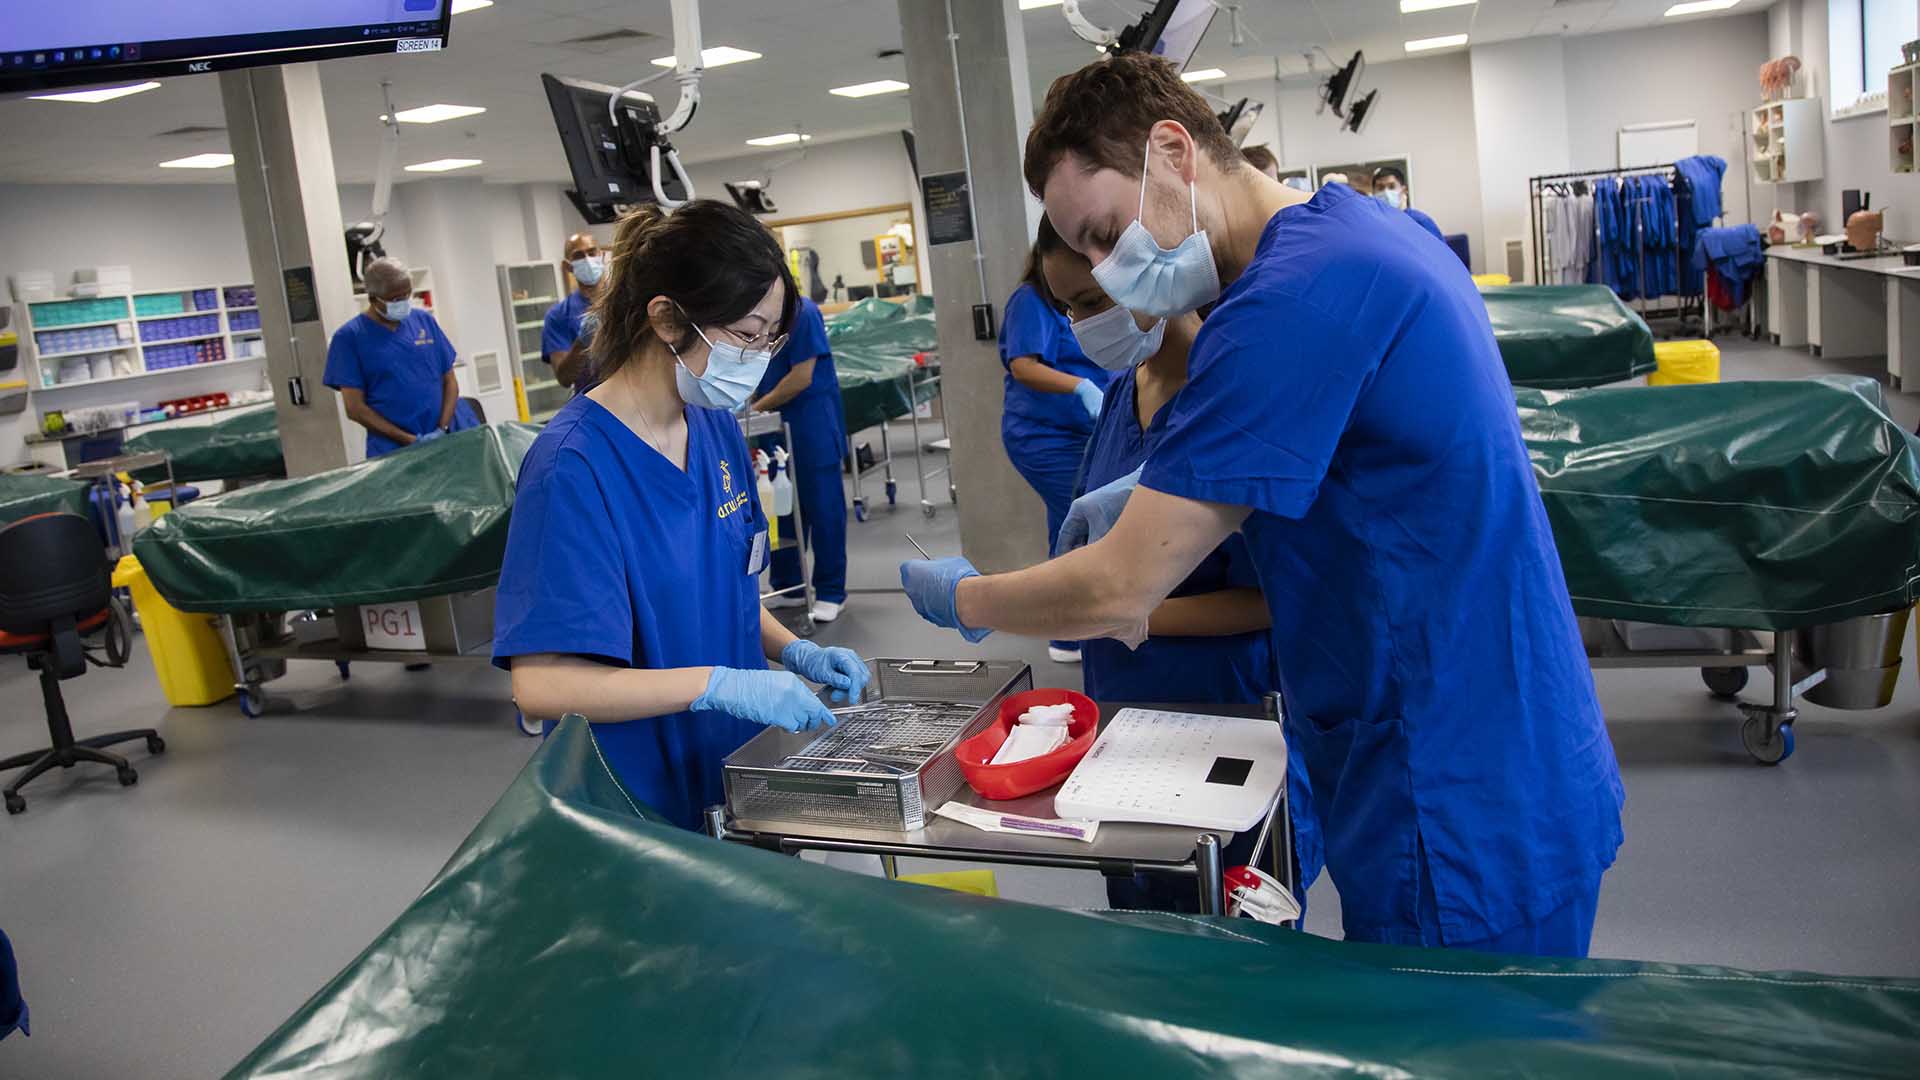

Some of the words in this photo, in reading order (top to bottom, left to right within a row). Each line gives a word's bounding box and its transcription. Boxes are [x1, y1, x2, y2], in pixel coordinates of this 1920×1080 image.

[398, 40, 429, 51] SCREEN
[431, 40, 438, 49] 14
[189, 61, 212, 72] NEC
[367, 608, 416, 635] PG1
